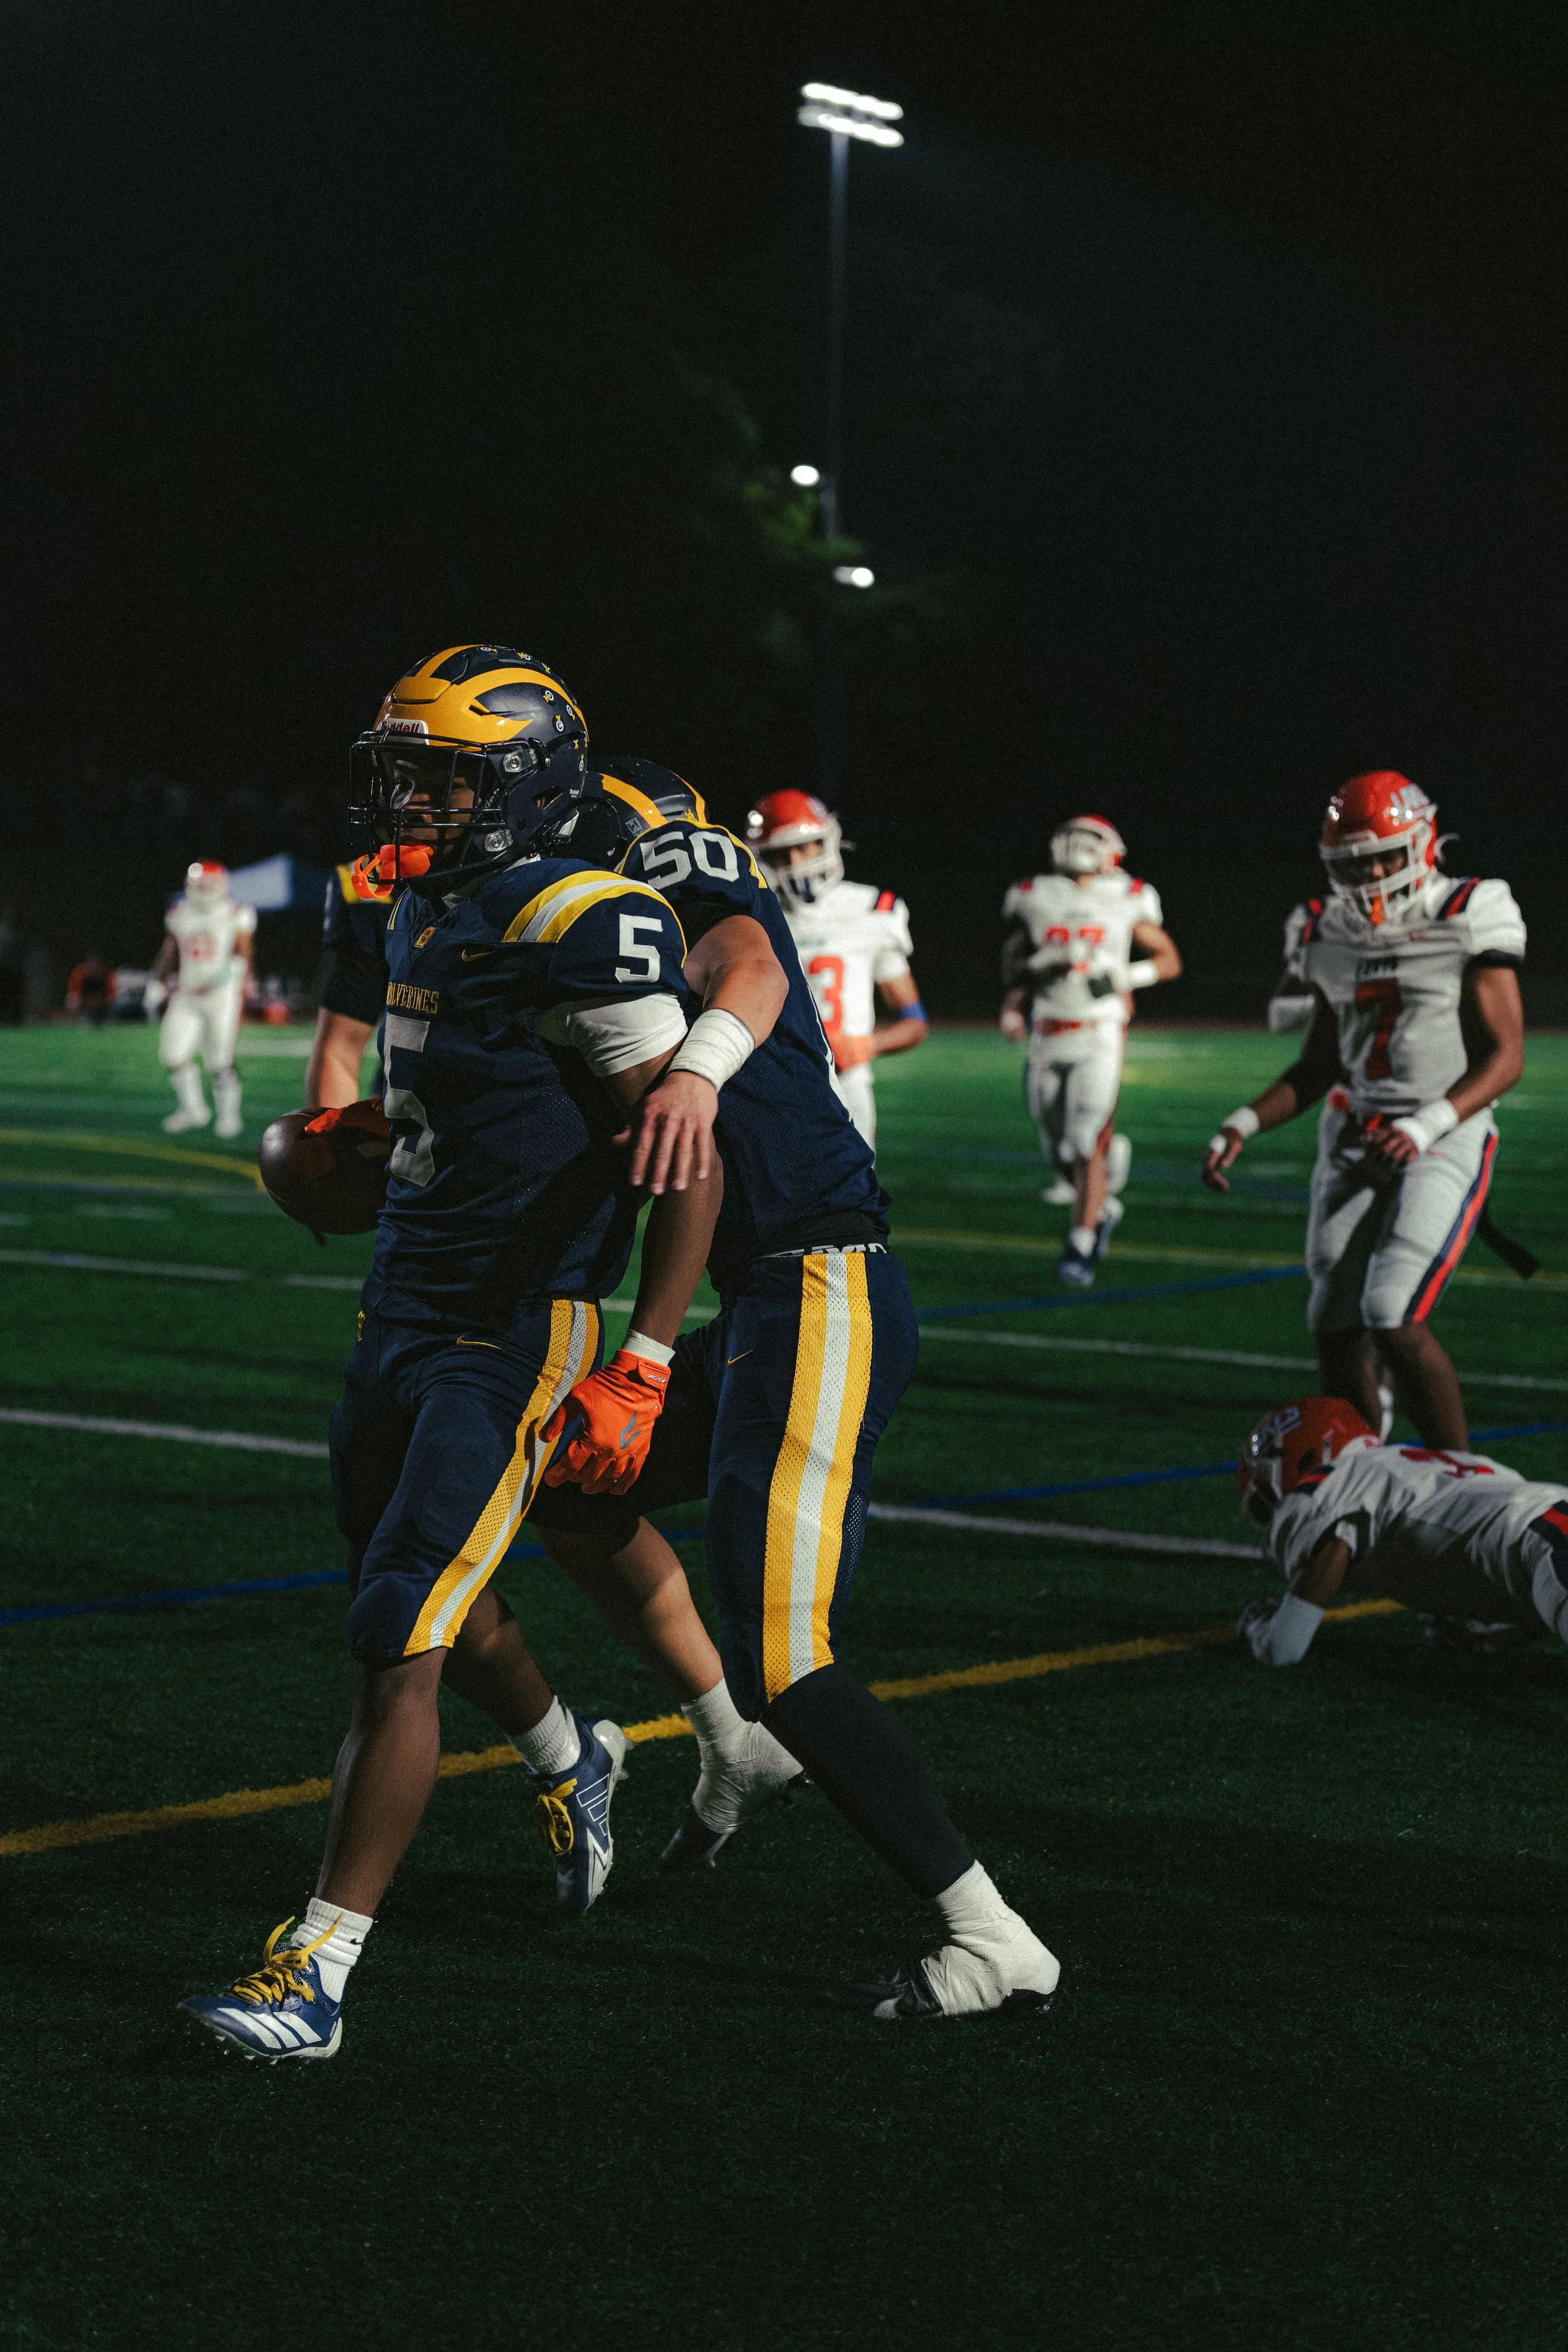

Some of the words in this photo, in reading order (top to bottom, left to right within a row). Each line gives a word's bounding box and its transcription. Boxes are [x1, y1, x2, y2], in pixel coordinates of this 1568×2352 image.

[639, 830, 739, 890] 50
[615, 913, 662, 983] 5
[386, 982, 439, 1014] OLVERINES
[1355, 977, 1399, 1079] 7
[383, 1014, 435, 1187] 5
